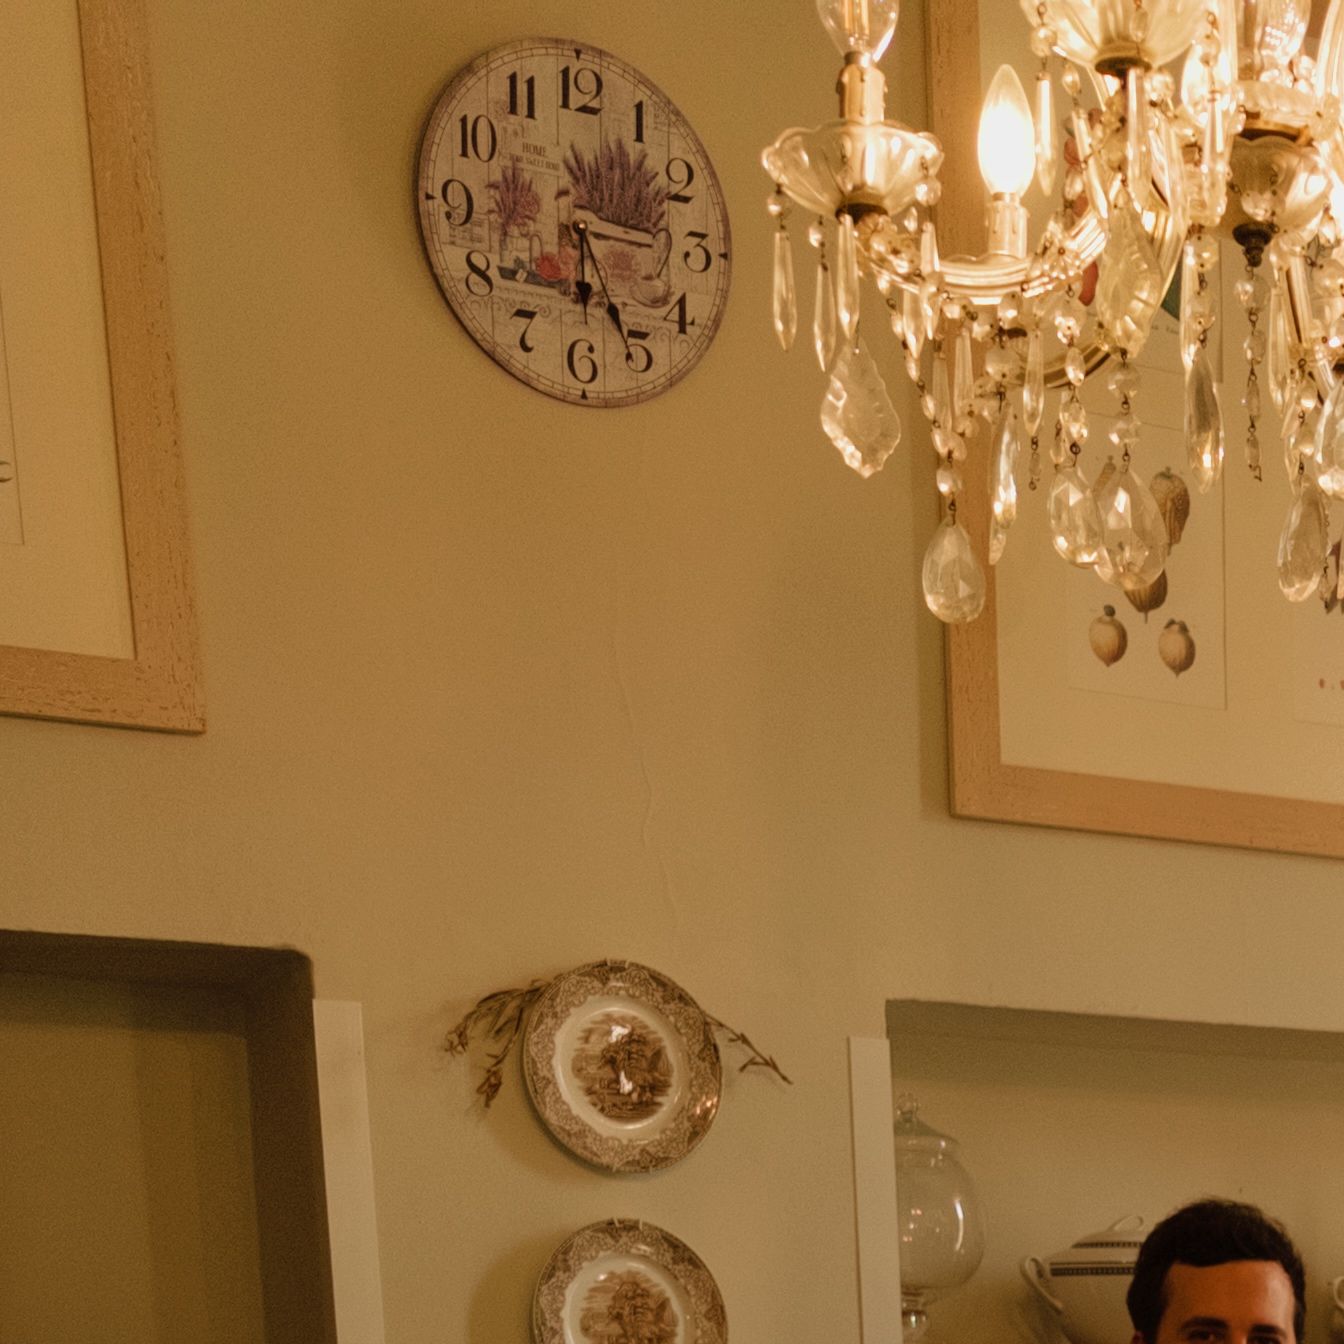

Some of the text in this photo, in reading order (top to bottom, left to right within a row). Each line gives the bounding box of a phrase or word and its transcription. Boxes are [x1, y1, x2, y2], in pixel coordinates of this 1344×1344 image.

[506, 71, 538, 121] 11
[559, 65, 604, 116] 12
[459, 114, 497, 163] 10
[633, 100, 645, 144] 1
[441, 179, 474, 227] 9
[665, 157, 695, 204] 2
[465, 250, 494, 297] 8
[684, 230, 712, 273] 3
[510, 308, 538, 353] 7
[663, 292, 695, 335] 4
[566, 339, 598, 384] 6
[625, 329, 653, 373] 5
